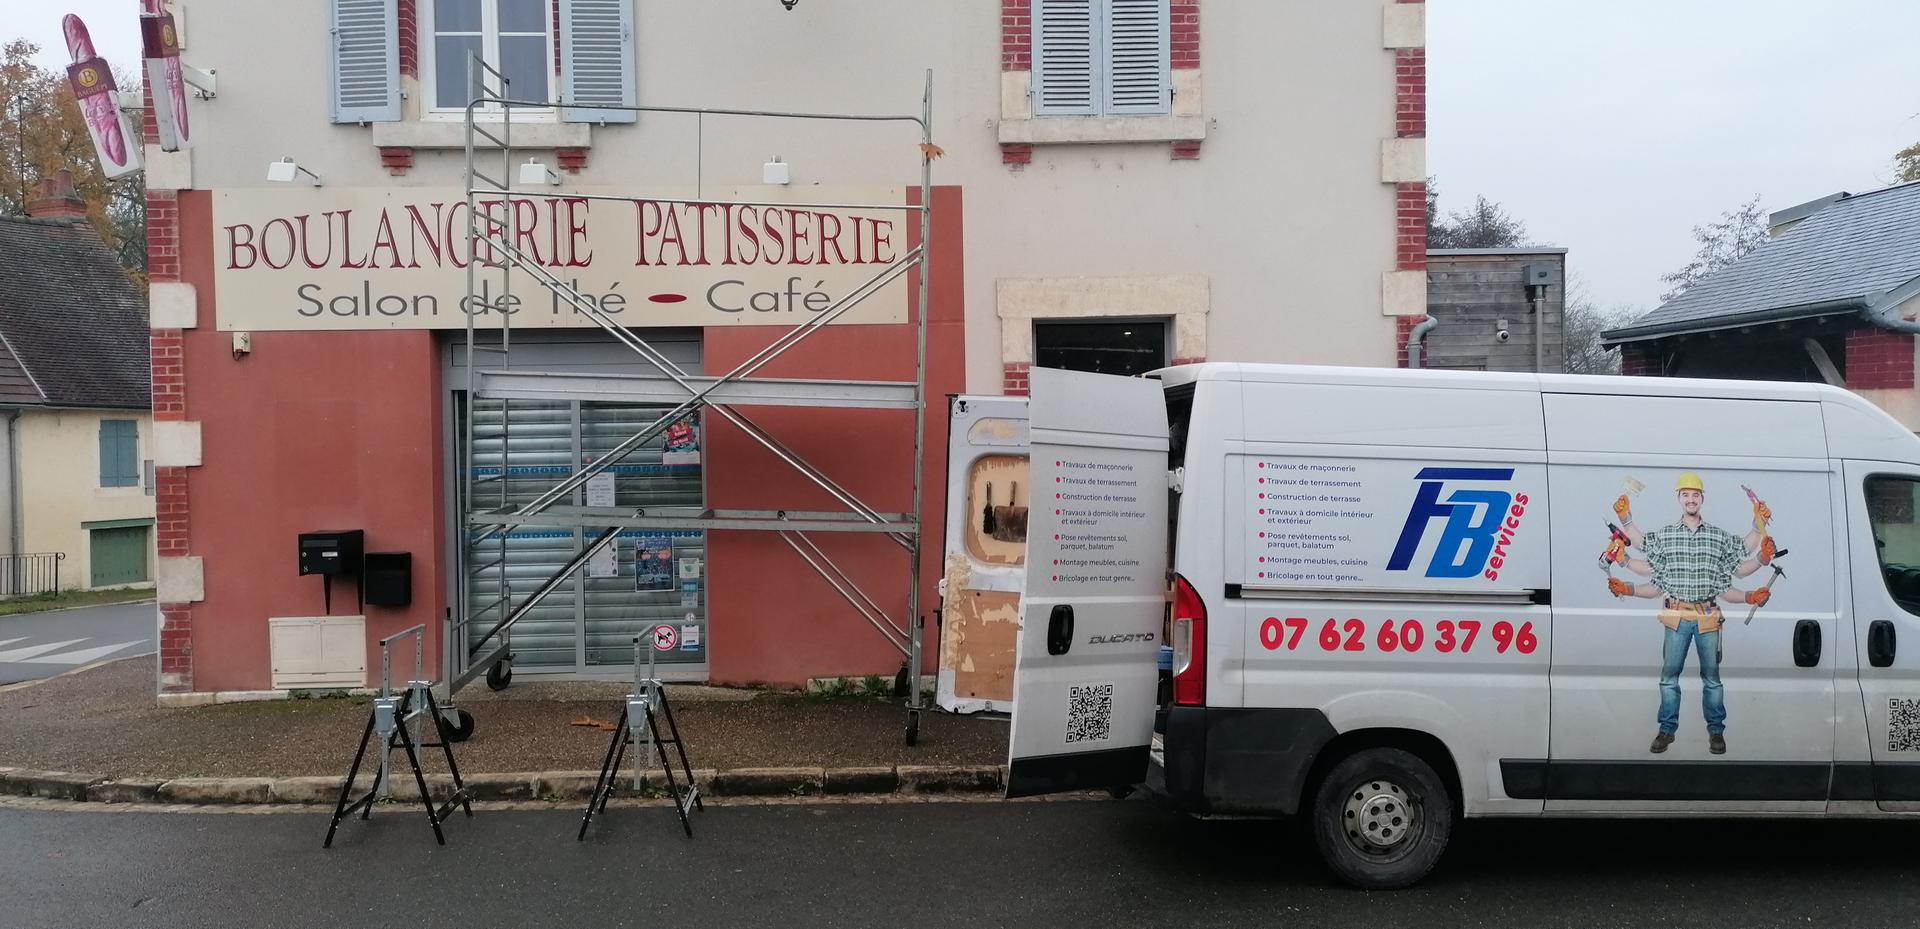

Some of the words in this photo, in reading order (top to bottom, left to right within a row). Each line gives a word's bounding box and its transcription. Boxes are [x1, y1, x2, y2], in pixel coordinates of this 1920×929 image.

[223, 198, 593, 270] BOULANGERIE
[632, 198, 896, 267] PATISSERIE
[297, 280, 438, 317] Salon
[459, 279, 522, 315] de
[540, 278, 627, 315] Thé
[706, 276, 832, 314] Café
[1062, 460, 1086, 469] Travaux
[1097, 462, 1134, 471] maçonnerie
[1267, 462, 1297, 470] Travaux
[1062, 477, 1086, 485] Travaux
[1097, 478, 1137, 487] terrassement
[1267, 477, 1297, 485] Travaux
[1298, 478, 1309, 486] de
[1310, 479, 1362, 487] terrassement
[1062, 493, 1103, 501] Construction
[1112, 495, 1137, 503] terrasse
[1267, 493, 1317, 501] Construction
[1318, 494, 1329, 502] de
[1330, 495, 1361, 503] terrasse
[1062, 509, 1086, 517] Travaux
[1120, 510, 1145, 518] intérieur
[1267, 508, 1298, 516] Travaux
[1305, 509, 1339, 517] domicile
[1340, 510, 1374, 519] intérieur
[1277, 517, 1312, 525] extérieur
[1078, 534, 1117, 542] revêtements
[1267, 532, 1286, 540] Pose
[1288, 532, 1336, 541] revêtements
[1338, 534, 1352, 543] sol,
[1484, 492, 1530, 582] services
[1267, 541, 1300, 550] parquet,
[1060, 559, 1088, 567] Montage
[1267, 556, 1302, 565] Montage
[1304, 558, 1339, 566] meubles,
[1340, 558, 1368, 566] cuisine
[1059, 575, 1088, 583] Bricolage
[1267, 571, 1304, 580] Bricolage
[1088, 633, 1155, 644] DUCATO
[1259, 617, 1309, 651] 07
[1318, 618, 1366, 652] 62
[1377, 619, 1425, 653] 60
[1434, 620, 1482, 653] 37
[1491, 621, 1538, 655] 96
